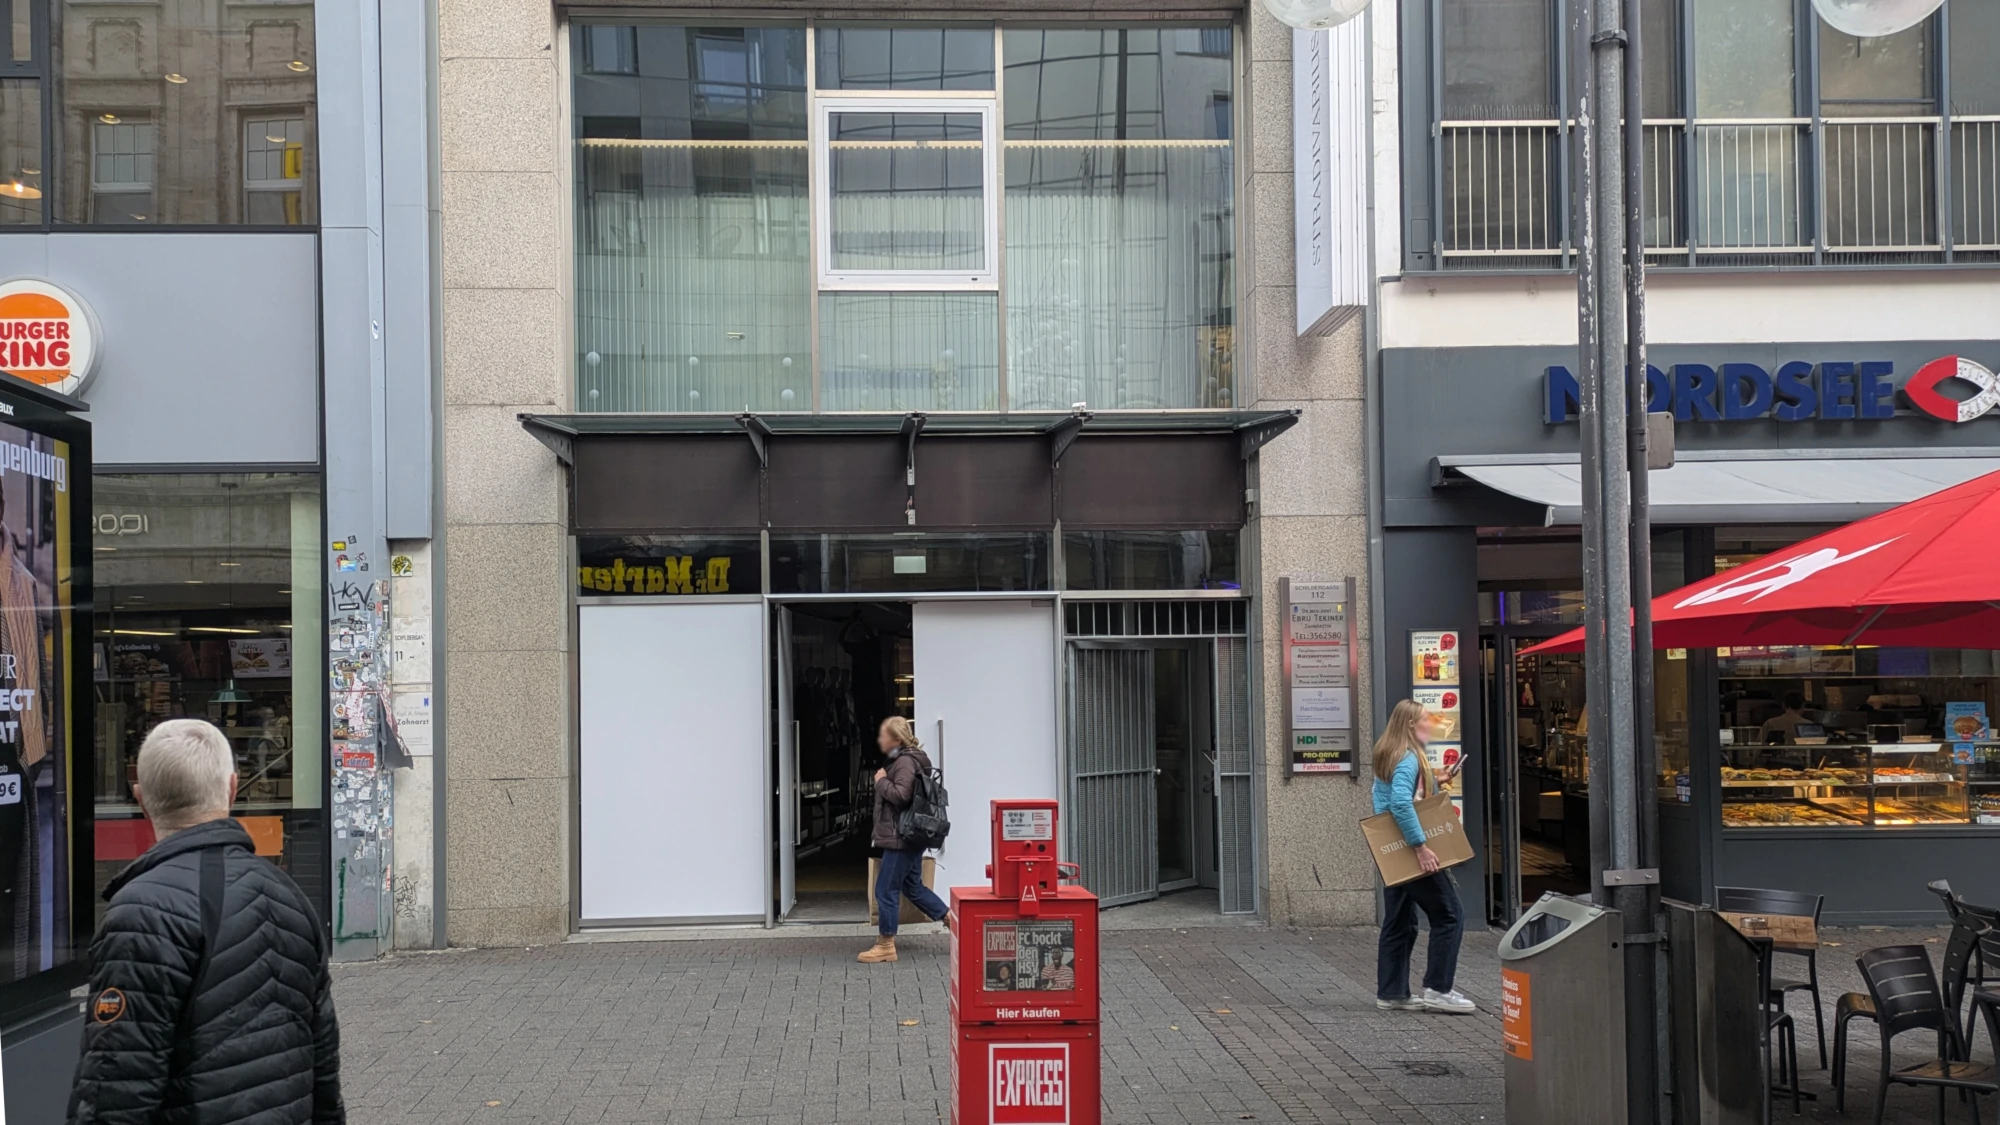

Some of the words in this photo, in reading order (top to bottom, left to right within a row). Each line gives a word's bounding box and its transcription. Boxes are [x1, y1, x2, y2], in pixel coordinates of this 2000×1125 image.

[1310, 30, 1322, 266] STRADIVARIUS
[1292, 614, 1311, 622] EBRU
[397, 718, 429, 726] Zahnarzt
[1297, 735, 1317, 744] HDI
[1303, 763, 1340, 771] Fahrschulen
[987, 931, 1015, 951] EXPRESS
[1018, 932, 1030, 945] FC
[1032, 931, 1062, 945] bockt
[1018, 946, 1038, 959] den
[1018, 961, 1039, 974] HSV
[1018, 976, 1037, 989] auf
[996, 1008, 1020, 1019] Hier
[1022, 1007, 1061, 1019] kaufen
[996, 1059, 1063, 1106] EXPRESS
